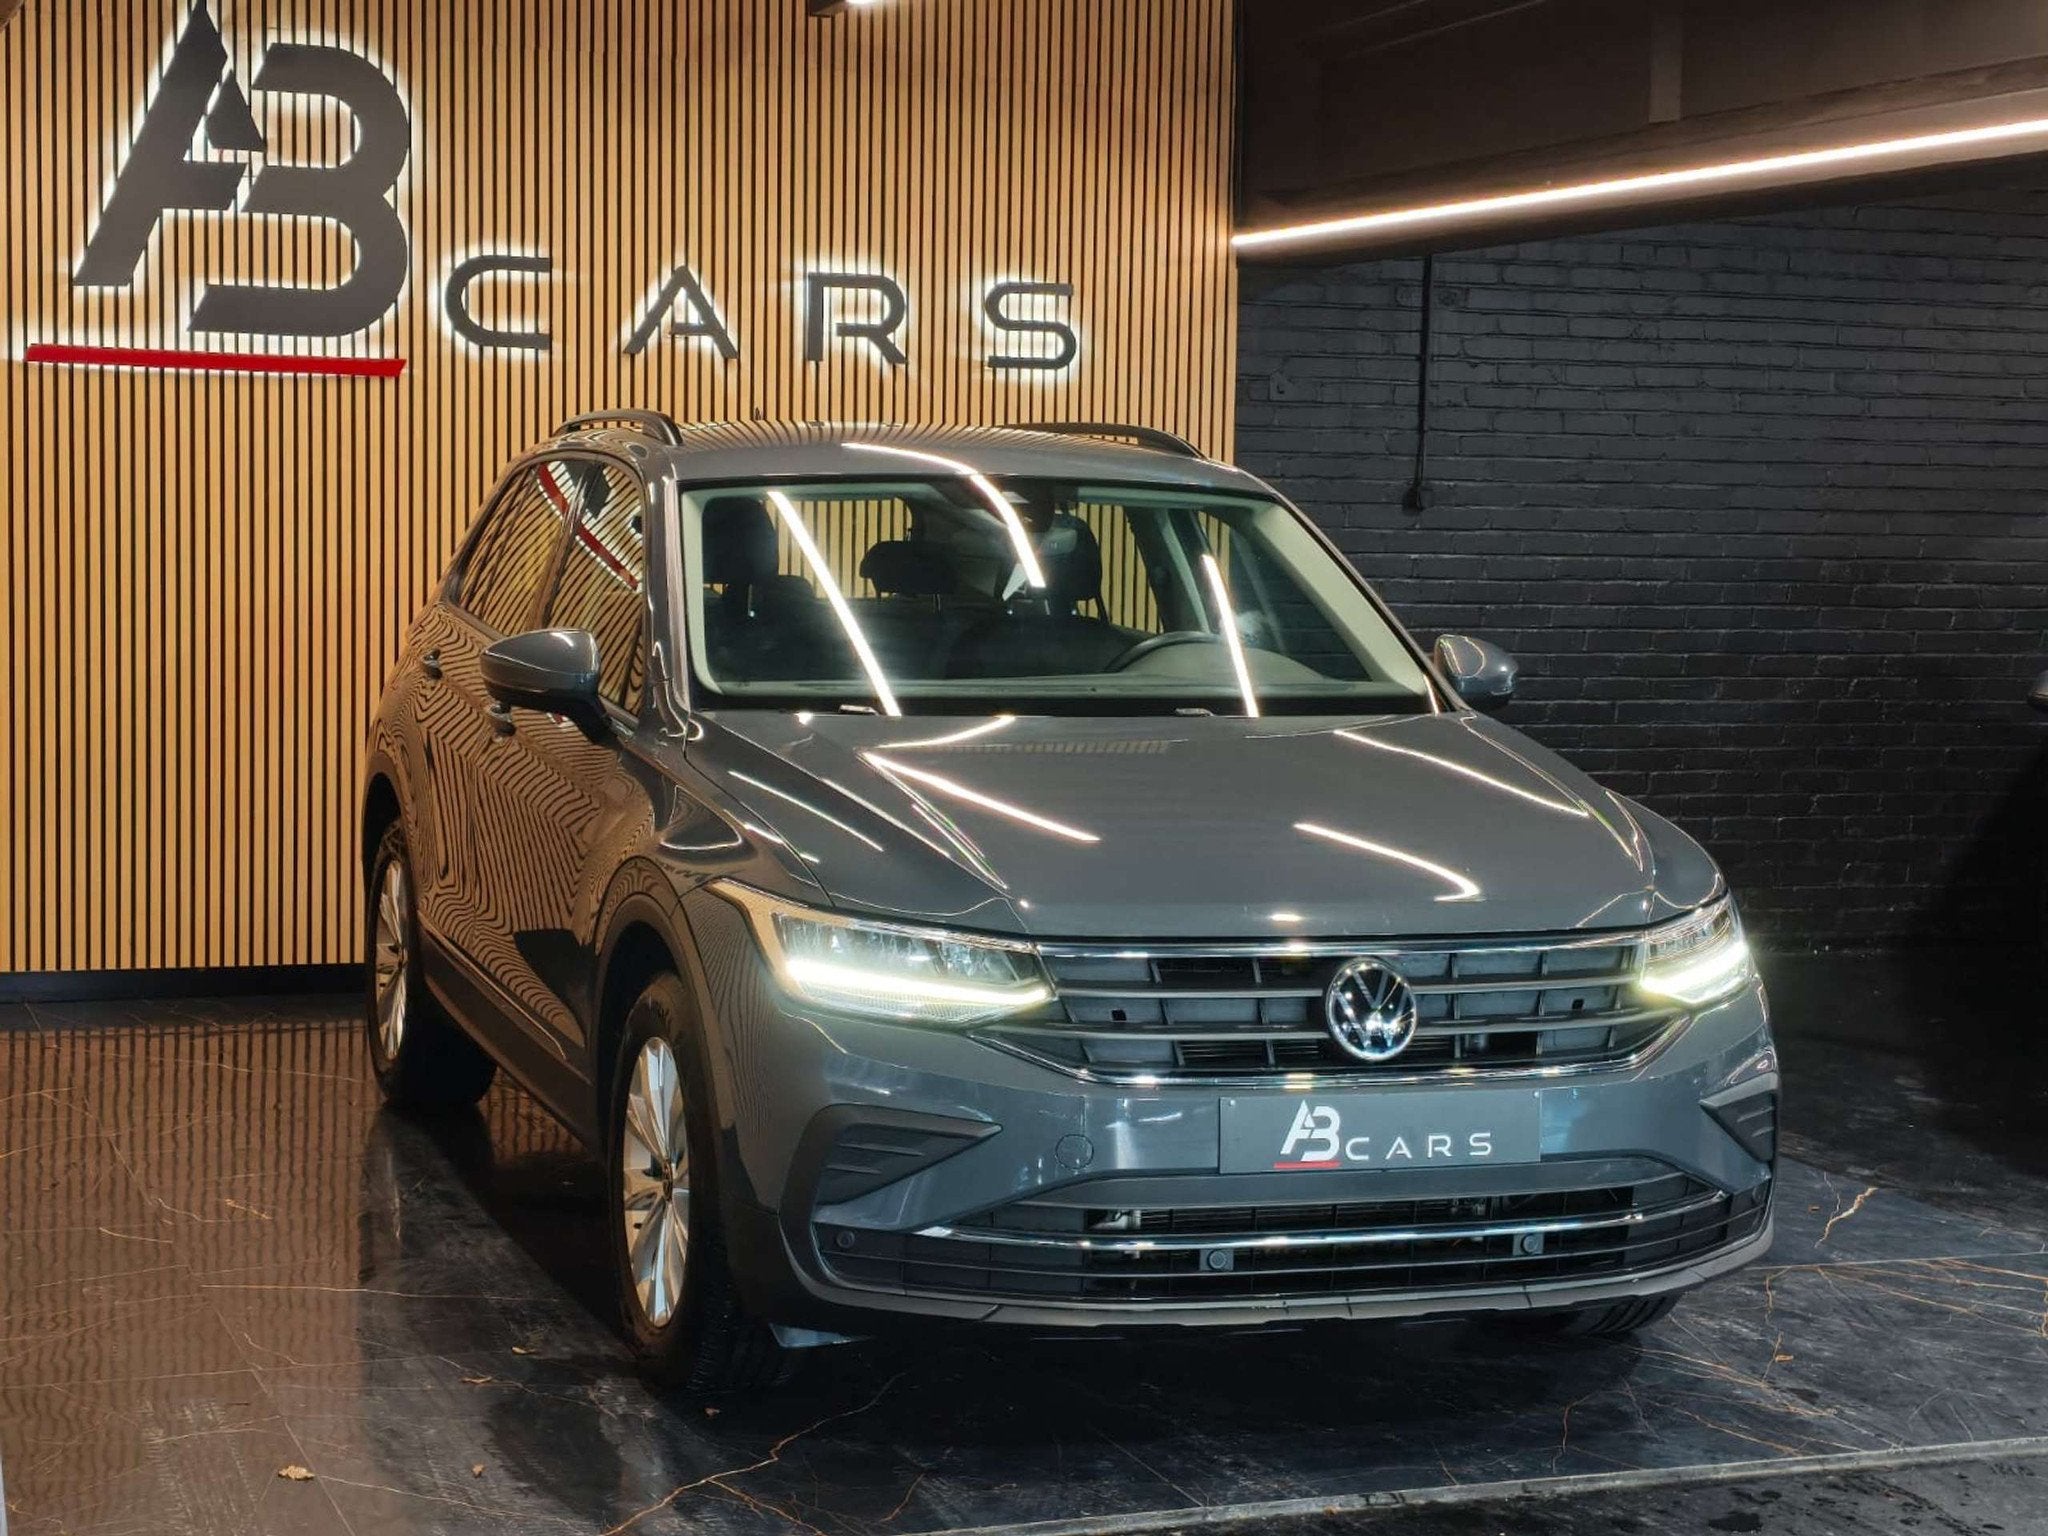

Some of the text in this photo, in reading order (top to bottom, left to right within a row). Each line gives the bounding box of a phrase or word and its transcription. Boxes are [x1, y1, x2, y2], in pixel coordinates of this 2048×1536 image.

[72, 0, 1078, 370] AB CARS
[1280, 1100, 1492, 1162] AB CARS
